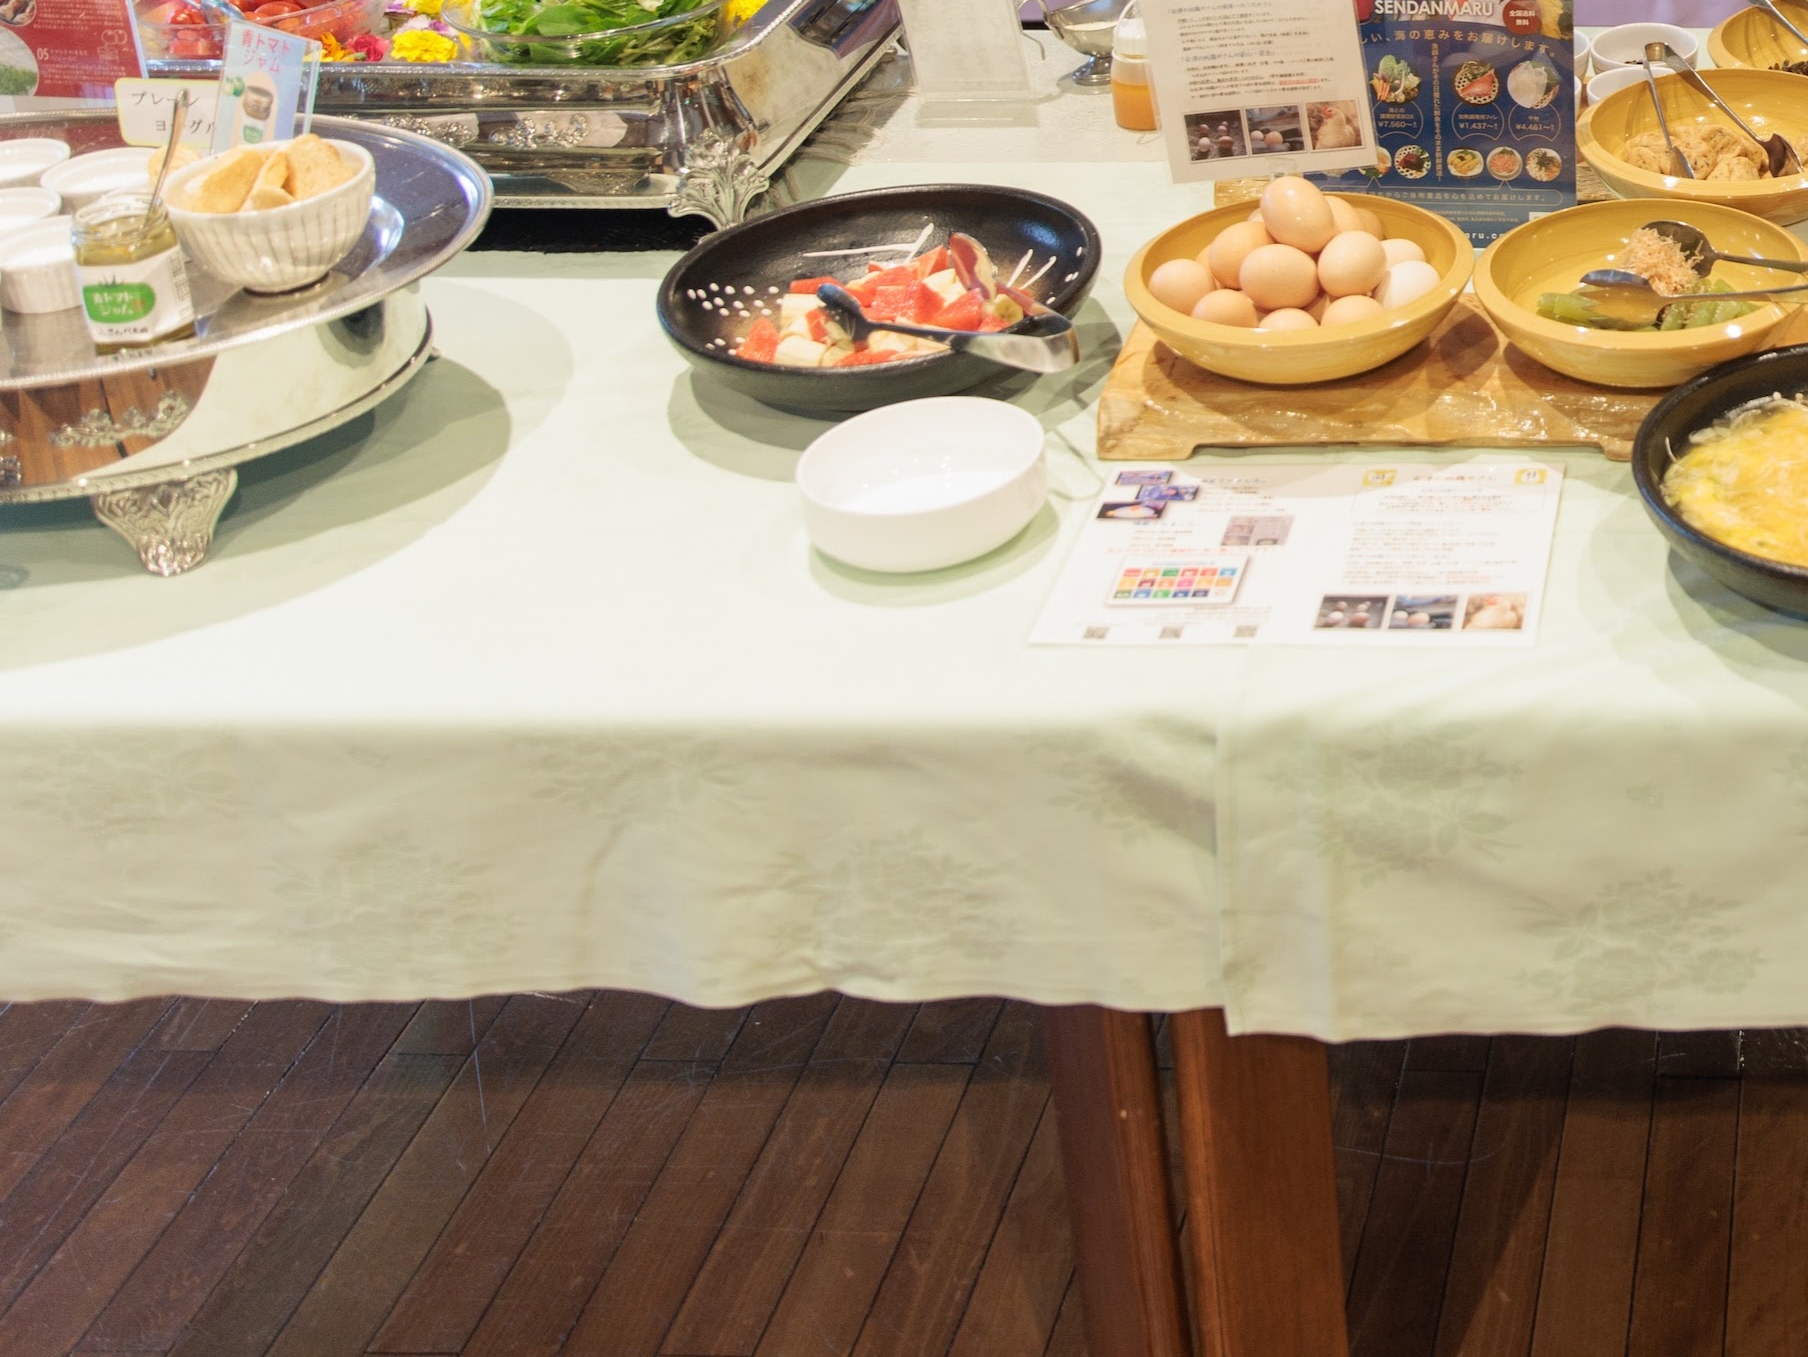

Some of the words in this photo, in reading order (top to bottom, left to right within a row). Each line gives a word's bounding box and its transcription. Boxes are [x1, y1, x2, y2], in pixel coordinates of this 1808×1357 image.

[1372, 0, 1493, 15] SENDANMARU
[242, 29, 291, 54] 青トマト
[36, 47, 49, 60] 05
[243, 50, 280, 73] ジャム
